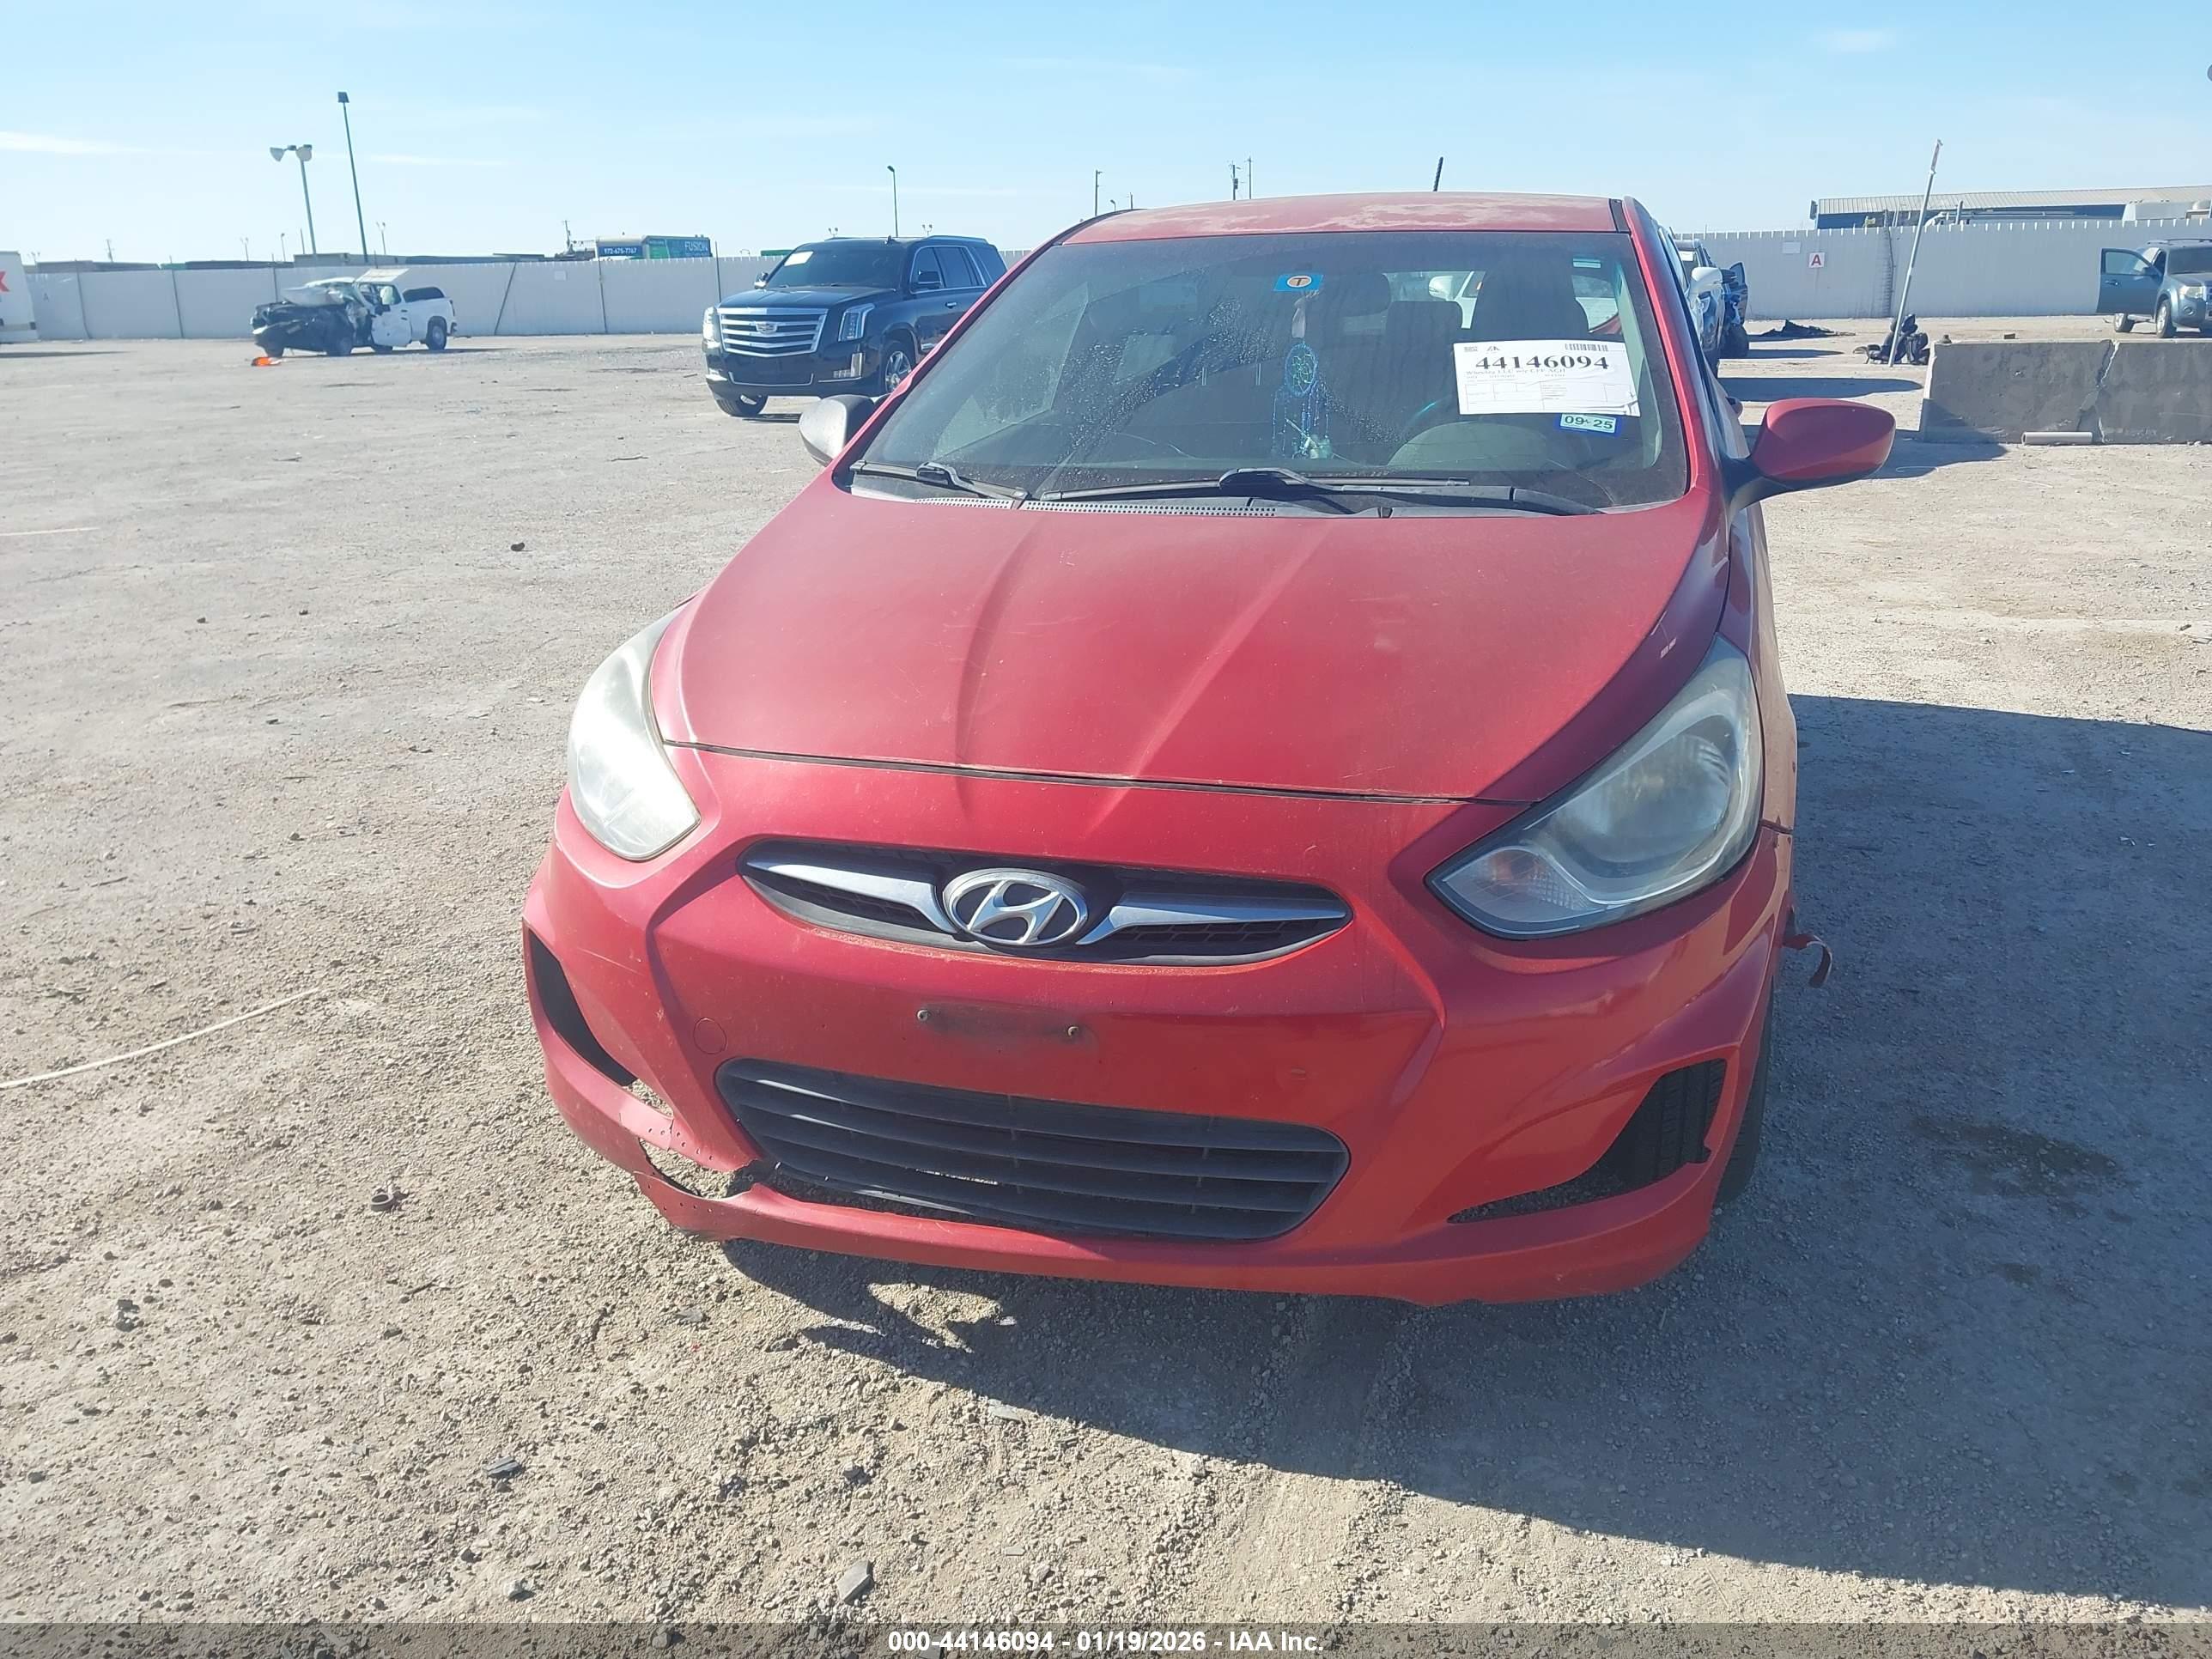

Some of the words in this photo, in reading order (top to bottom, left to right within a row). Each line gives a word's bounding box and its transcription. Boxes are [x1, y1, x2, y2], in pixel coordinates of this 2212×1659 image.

[1811, 254, 1821, 265] A
[1475, 356, 1609, 369] 44146094
[1565, 416, 1584, 425] 09
[1593, 419, 1613, 429] 25
